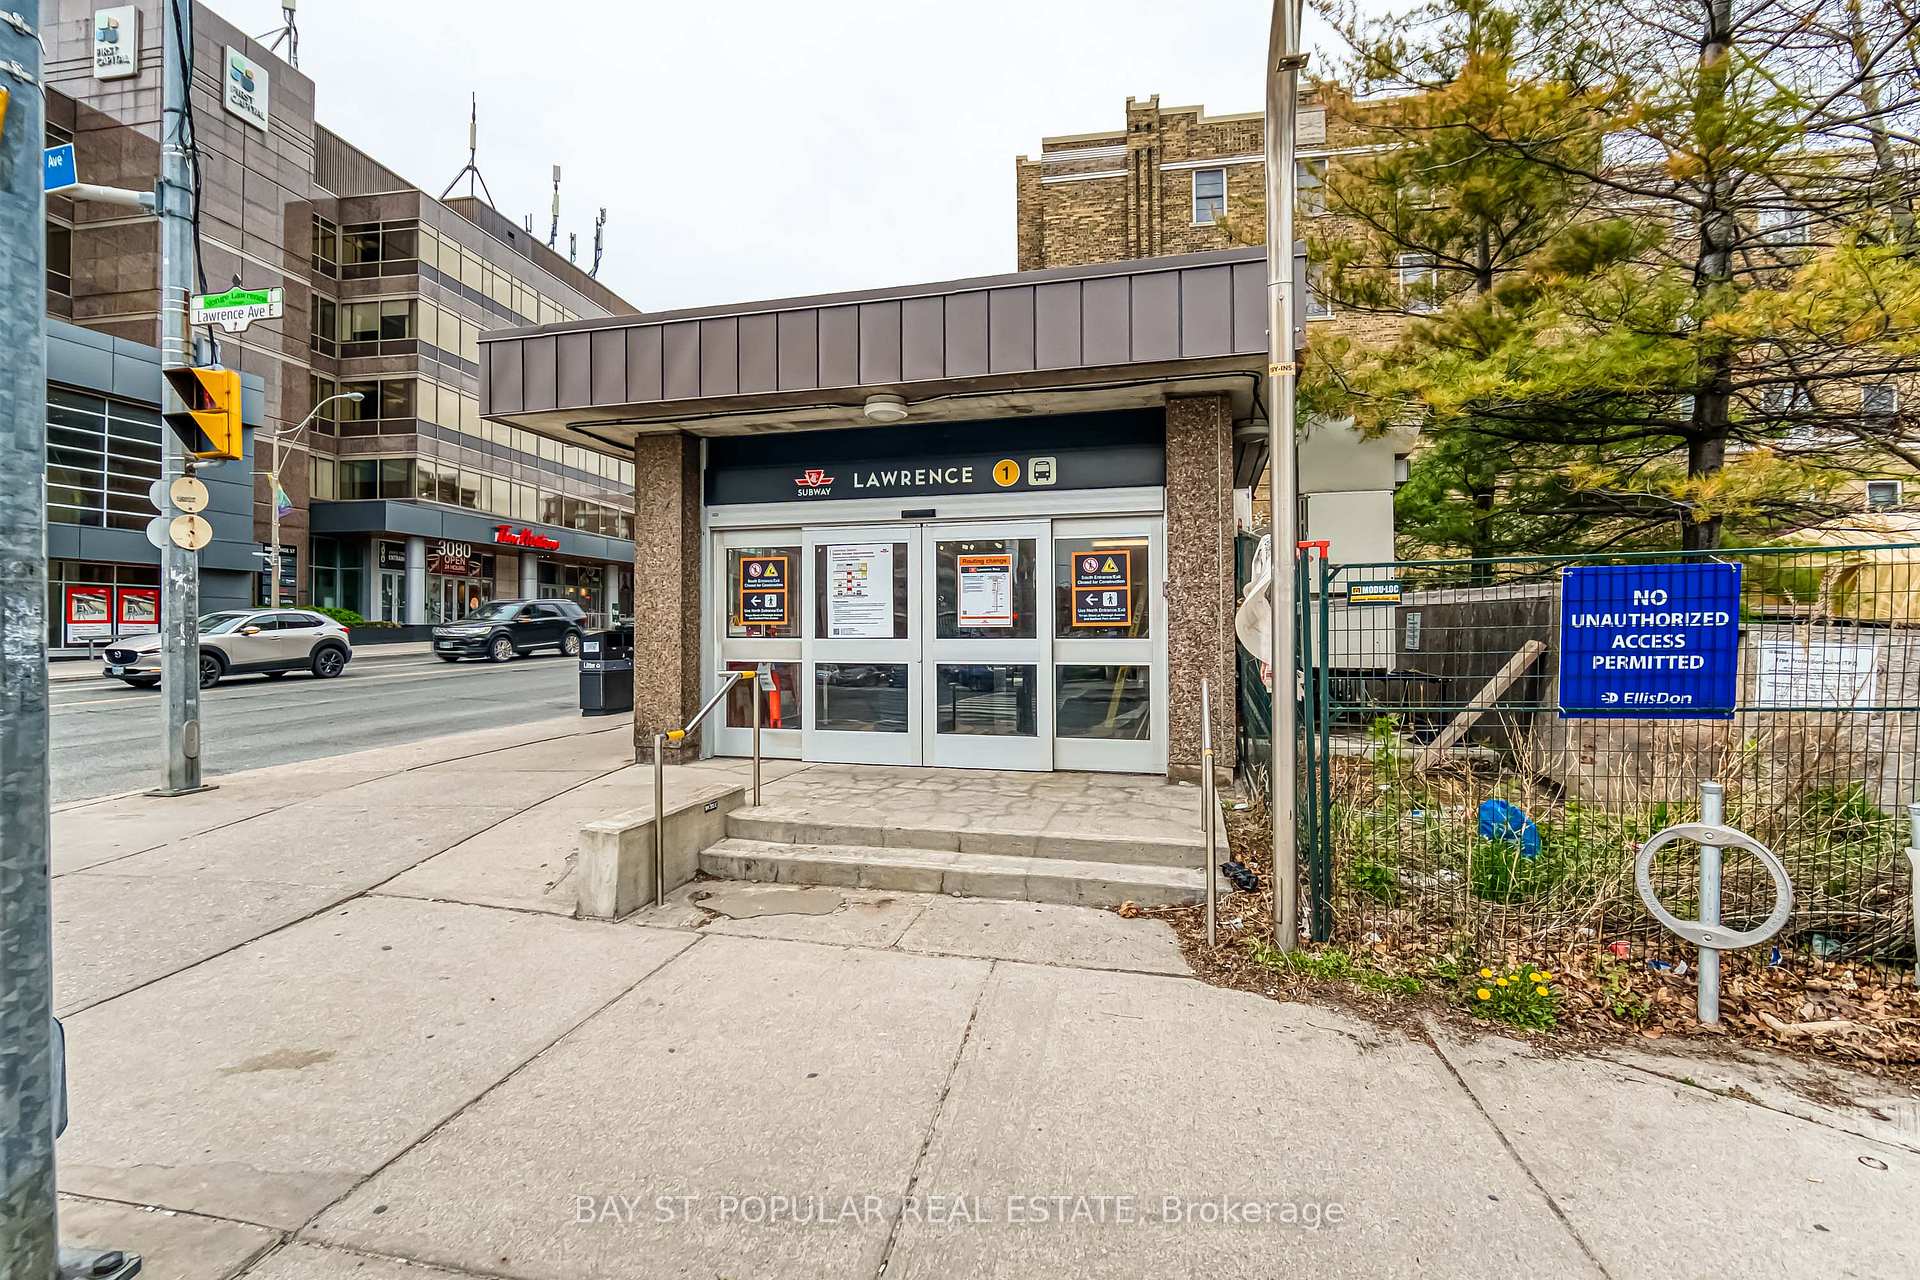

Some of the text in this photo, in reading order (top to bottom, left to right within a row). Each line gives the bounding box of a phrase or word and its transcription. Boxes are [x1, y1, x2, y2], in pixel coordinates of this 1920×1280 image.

[197, 304, 274, 322] Lawrence Ave E
[853, 466, 973, 489] LAWRENCE
[797, 487, 832, 497] SUBWAY
[438, 541, 471, 558] 3080
[444, 555, 466, 566] OPEN
[1633, 589, 1668, 606] NO
[1571, 611, 1730, 628] UNAUTHORIZED
[1611, 633, 1686, 649] ACCESS
[1592, 654, 1705, 670] PERMITTED
[1623, 691, 1692, 705] EllisDon
